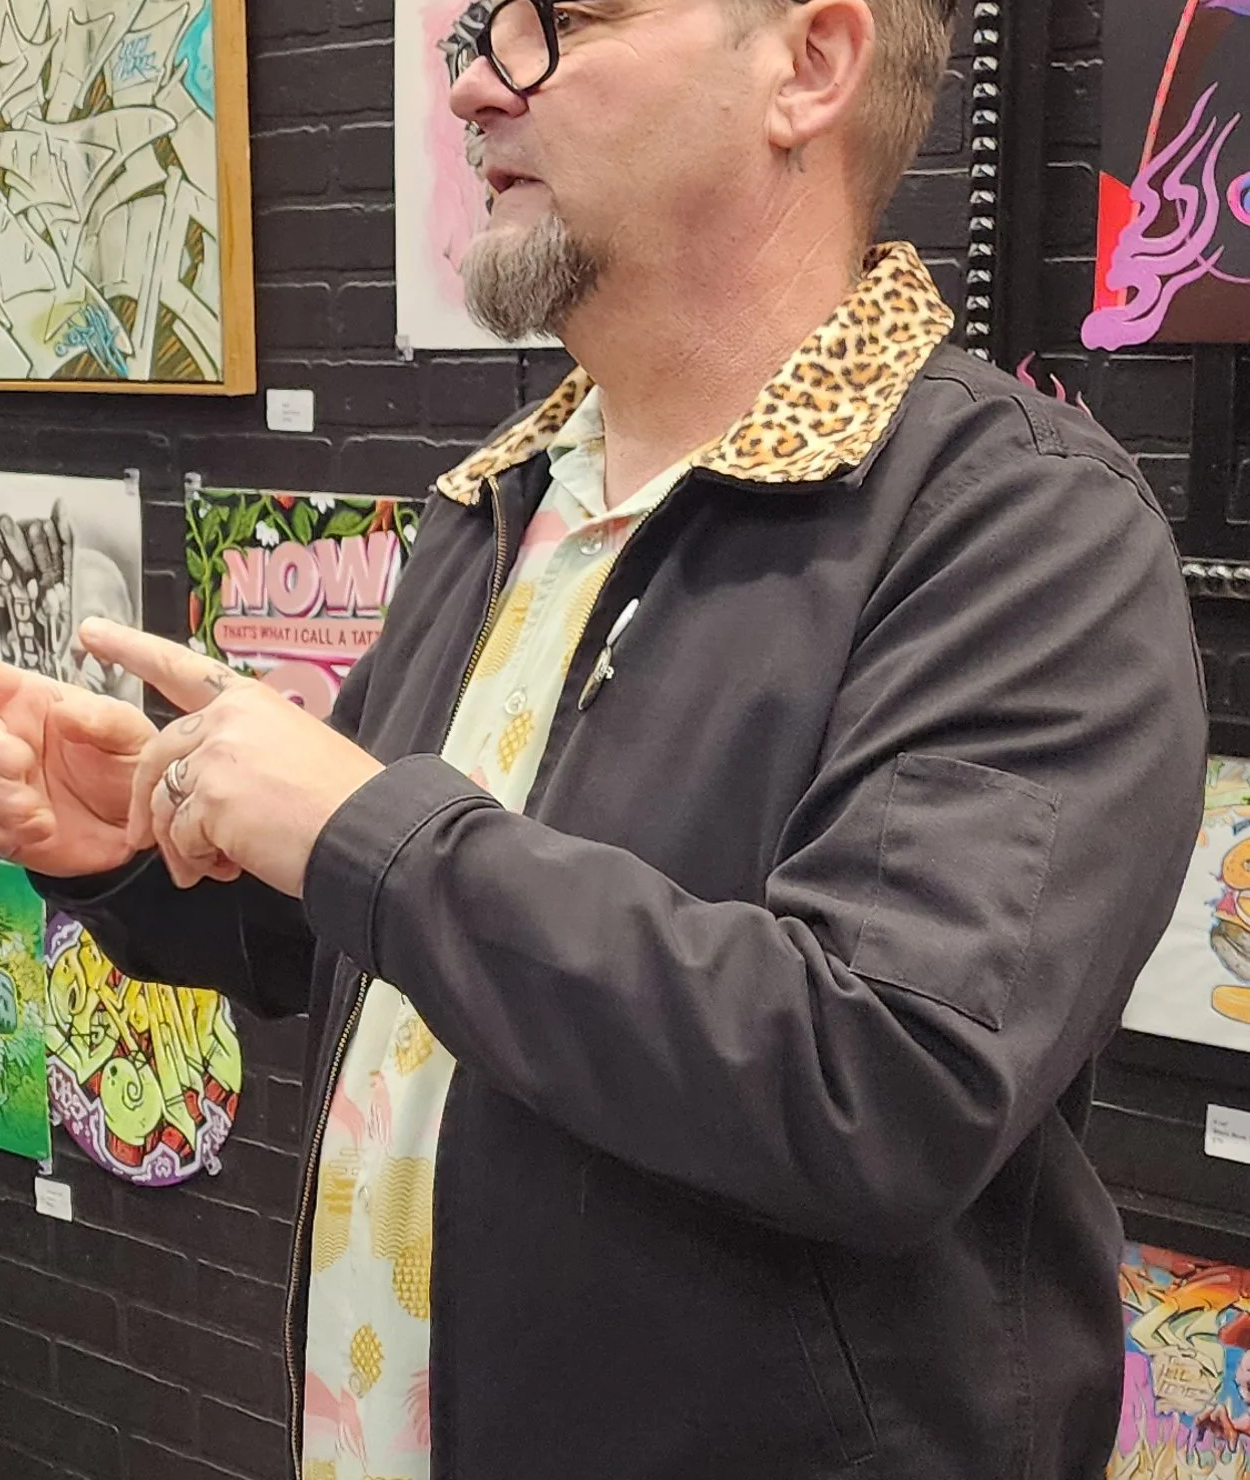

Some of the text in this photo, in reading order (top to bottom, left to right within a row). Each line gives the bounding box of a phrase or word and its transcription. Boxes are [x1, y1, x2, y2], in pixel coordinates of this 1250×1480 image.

[221, 530, 401, 619] NOW
[223, 624, 258, 641] THAT'S
[260, 625, 290, 642] WHAT
[301, 628, 334, 646] CALL
[338, 630, 347, 646] A
